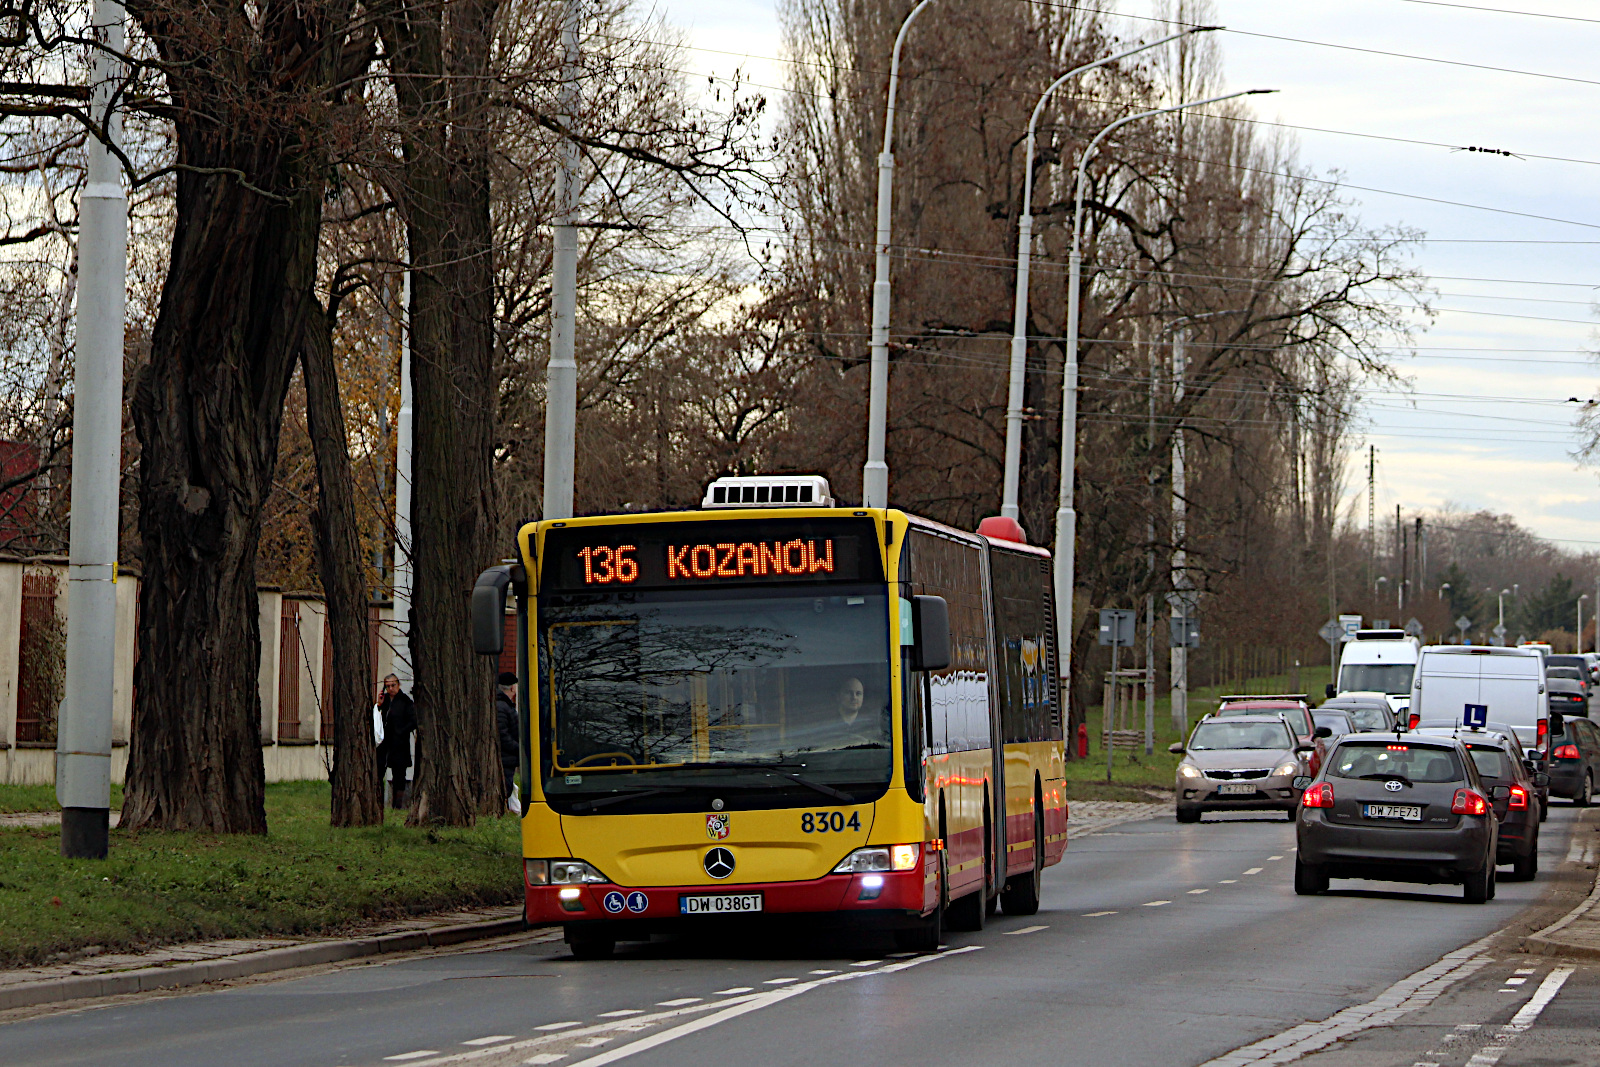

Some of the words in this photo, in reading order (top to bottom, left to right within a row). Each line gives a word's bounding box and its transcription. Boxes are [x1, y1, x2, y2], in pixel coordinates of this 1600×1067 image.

[577, 544, 638, 584] 136
[668, 538, 834, 579] KOZANÓW
[1470, 707, 1482, 725] L
[1370, 805, 1384, 816] DW
[1387, 806, 1418, 818] 7FE73
[801, 811, 861, 834] 8304
[689, 897, 710, 912] DW
[715, 896, 760, 911] 038GT
